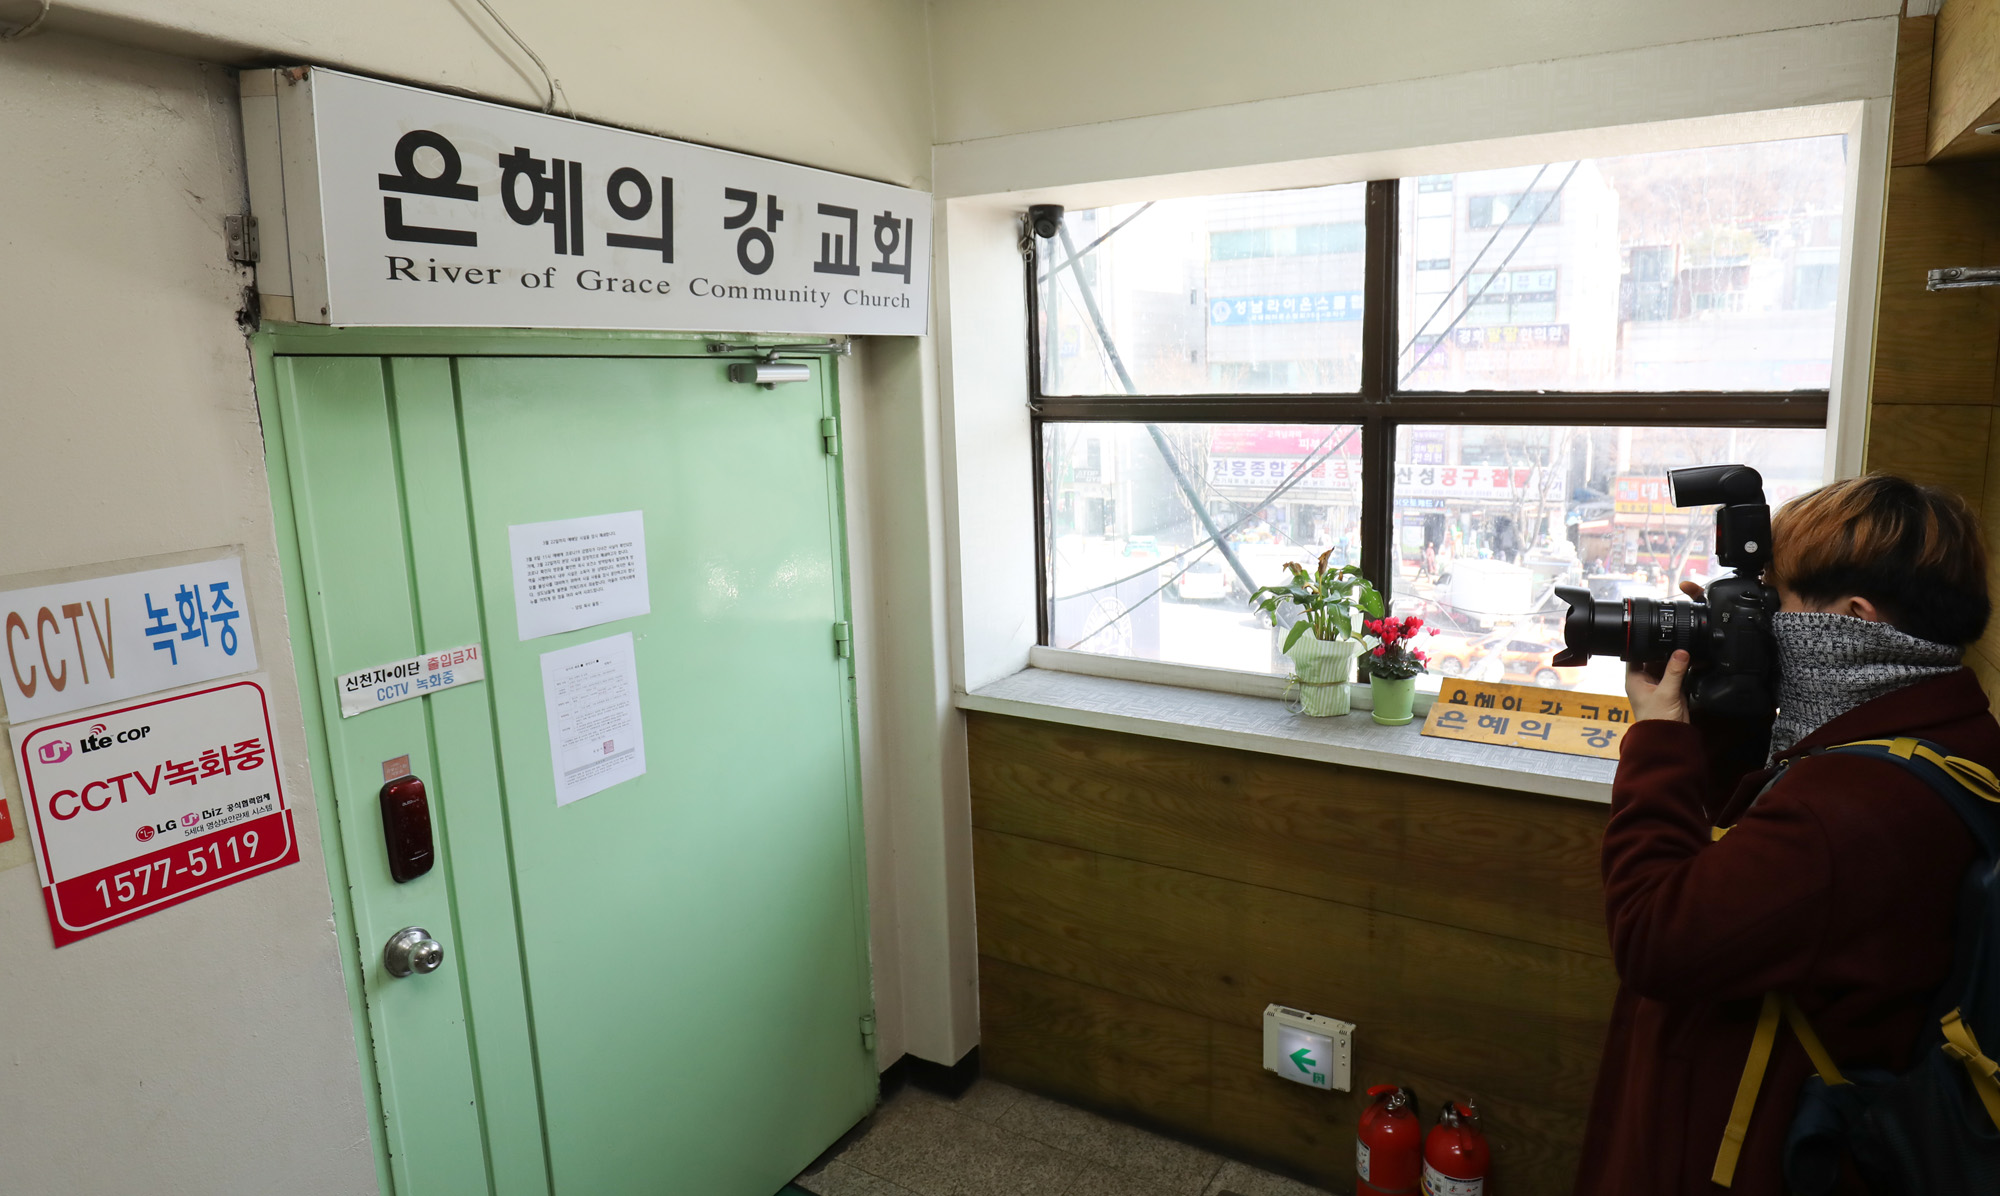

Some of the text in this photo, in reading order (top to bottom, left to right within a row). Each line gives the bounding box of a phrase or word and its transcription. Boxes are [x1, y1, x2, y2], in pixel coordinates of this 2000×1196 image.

[378, 129, 914, 284] 은혜의 강 교회
[385, 254, 911, 309] River of Grace Community Church
[5, 580, 240, 698] CCTV 녹화중
[427, 647, 478, 671] 출입금지
[377, 670, 455, 702] CCTV 녹화중
[116, 724, 151, 745] COP
[1436, 710, 1617, 749] 은혜의 강
[157, 819, 178, 836] LG
[202, 805, 223, 820] Biz
[95, 829, 260, 909] 1577-5119
